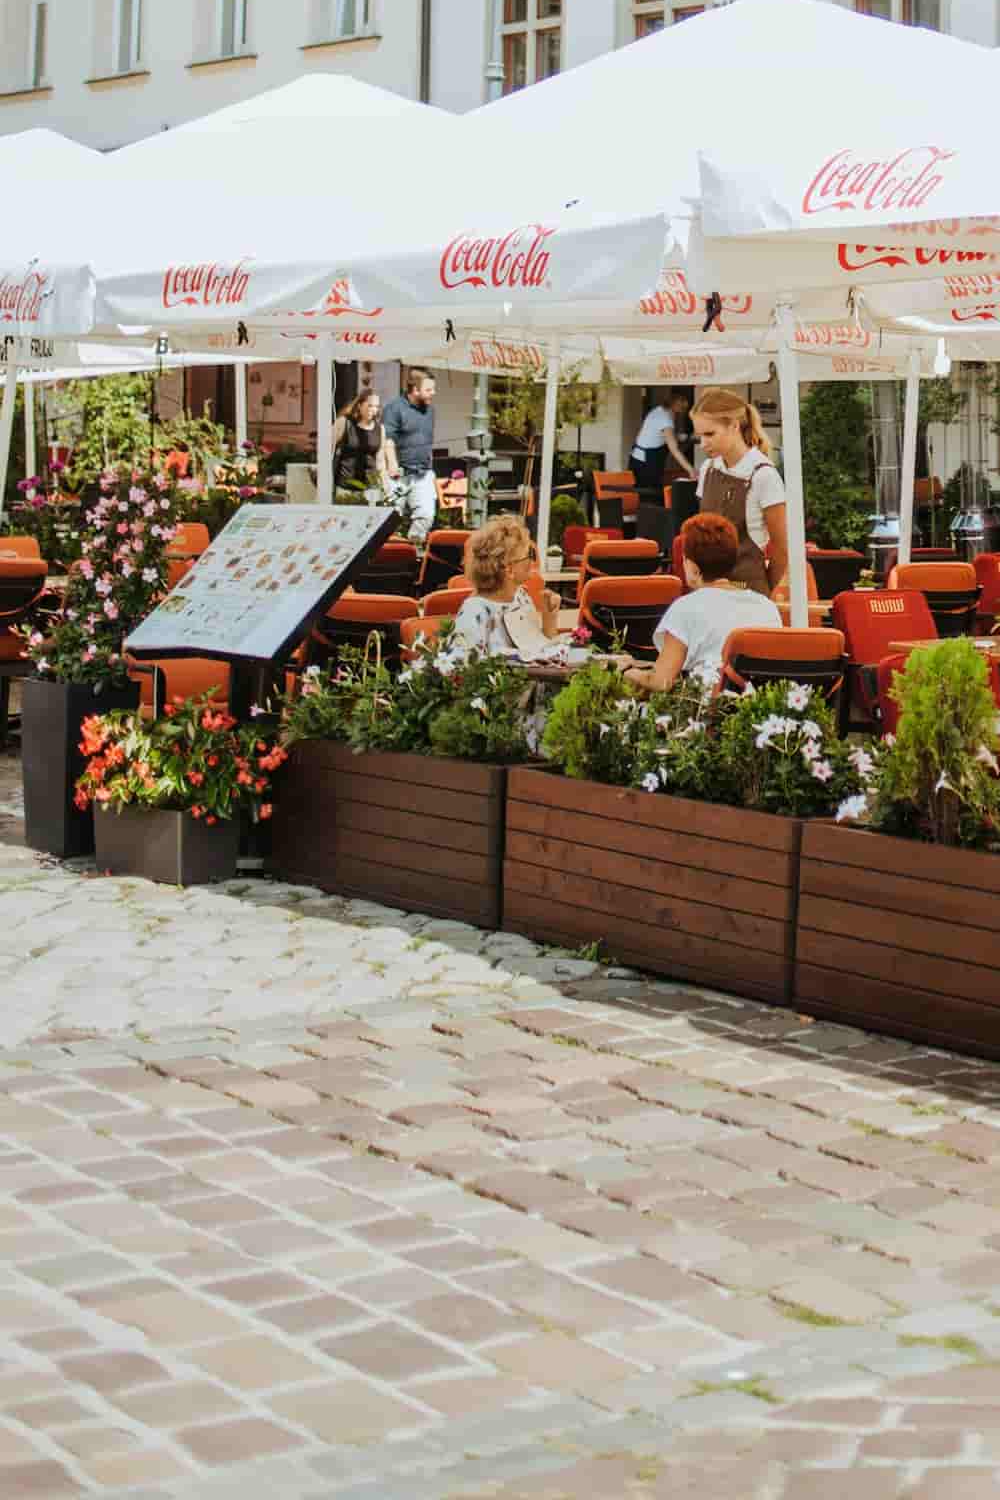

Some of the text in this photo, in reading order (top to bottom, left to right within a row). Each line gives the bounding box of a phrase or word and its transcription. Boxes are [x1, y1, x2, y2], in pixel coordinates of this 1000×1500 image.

[802, 146, 958, 214] Coca-Cola
[162, 260, 250, 309] Coca-Cola
[440, 224, 557, 290] Coca-Cola
